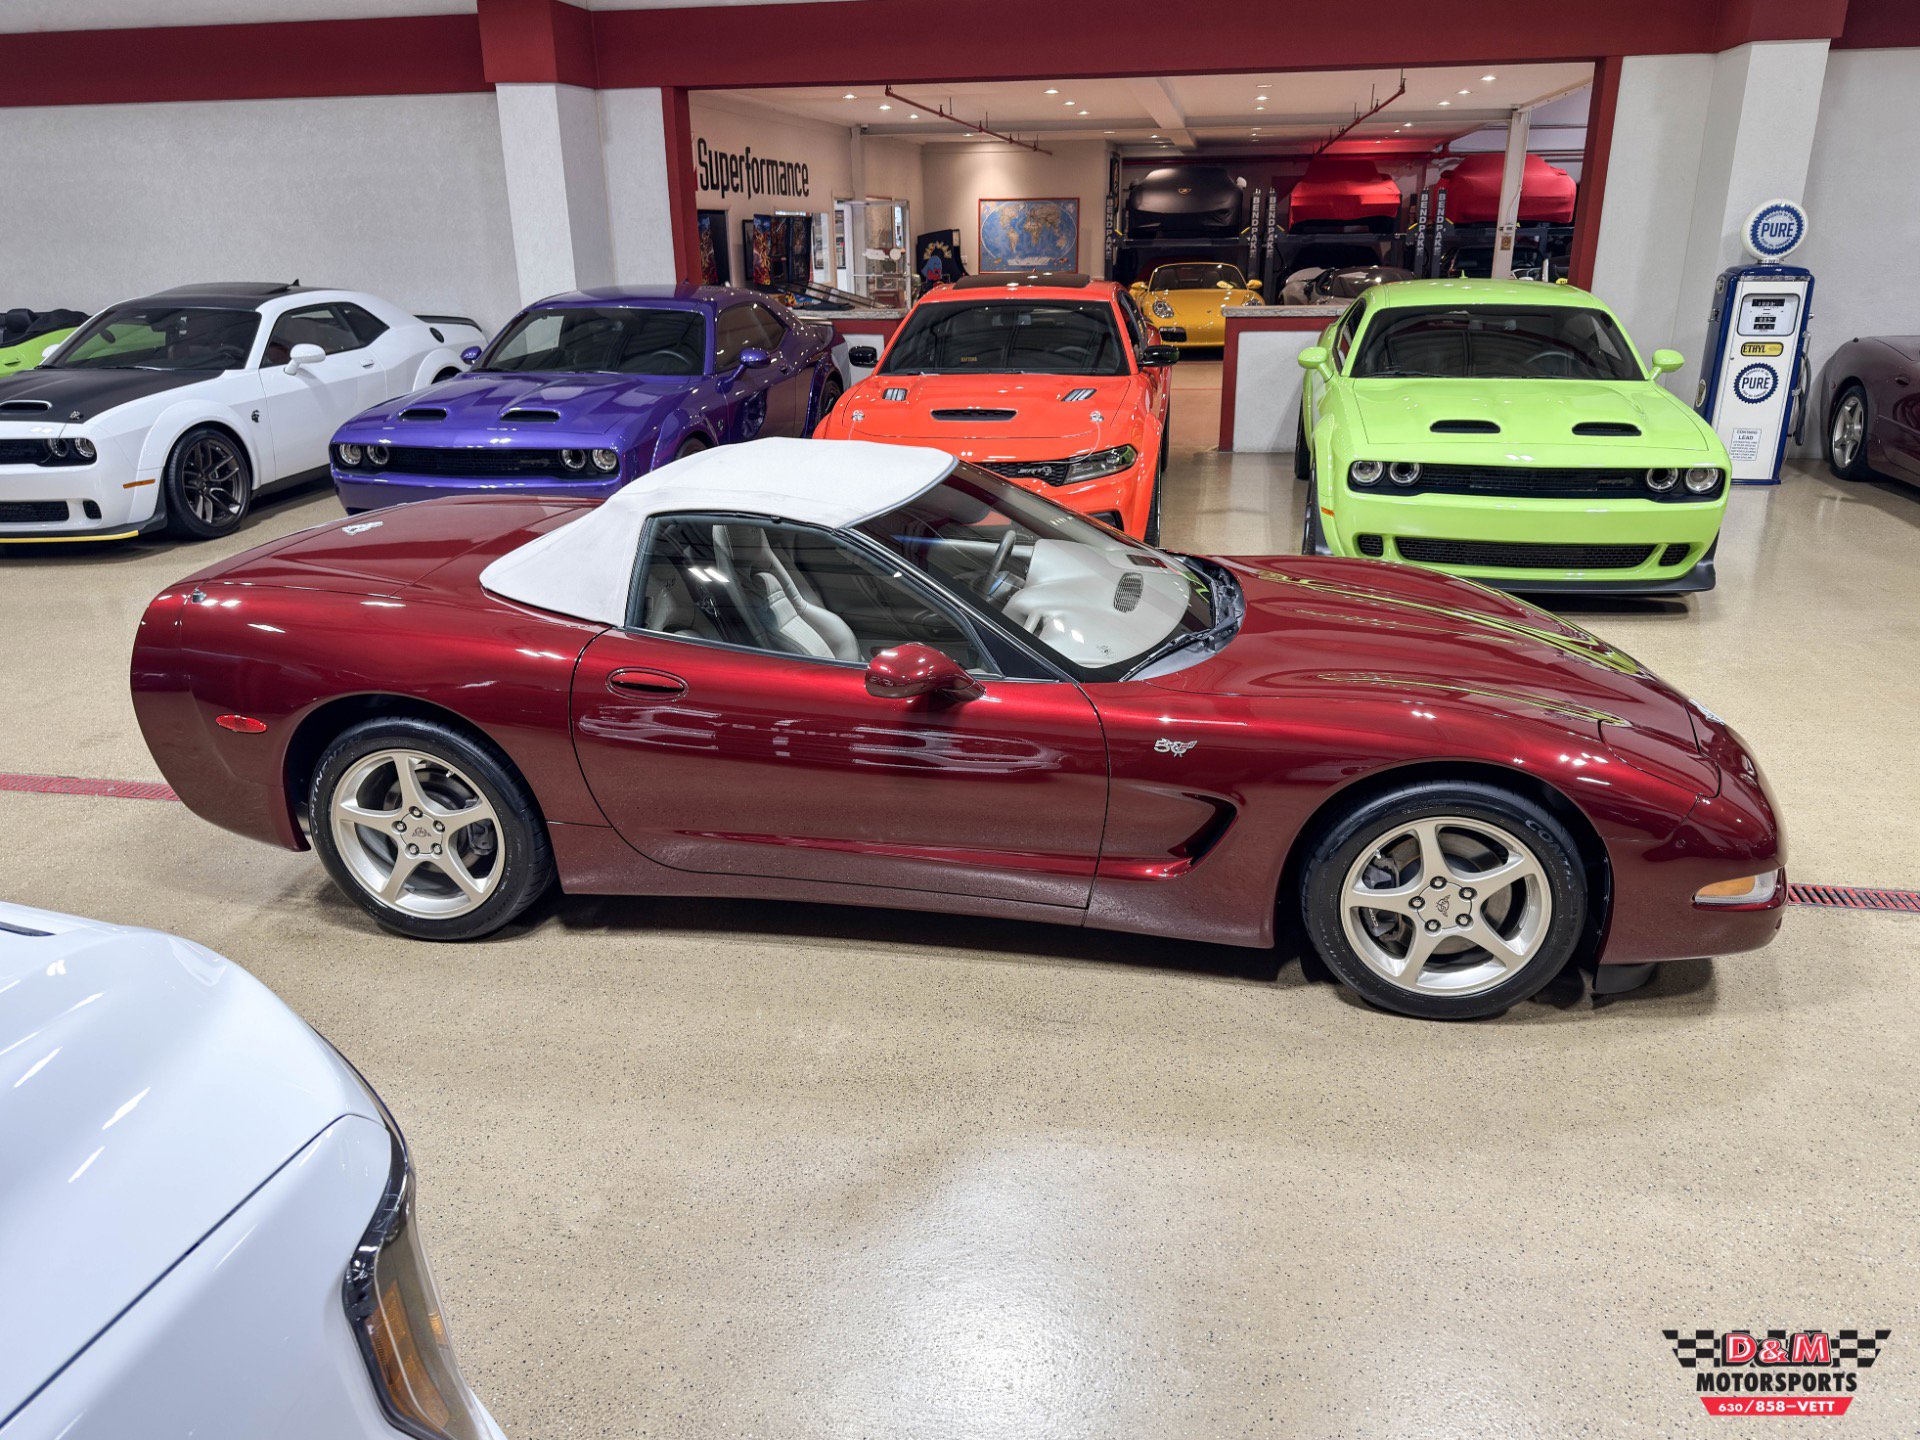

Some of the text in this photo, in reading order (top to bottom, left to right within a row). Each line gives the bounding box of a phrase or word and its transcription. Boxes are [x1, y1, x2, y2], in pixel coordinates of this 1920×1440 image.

[697, 137, 810, 200] Superformance
[1760, 222, 1795, 238] PURE
[1742, 344, 1767, 353] ETHYL
[1741, 377, 1771, 389] PURE
